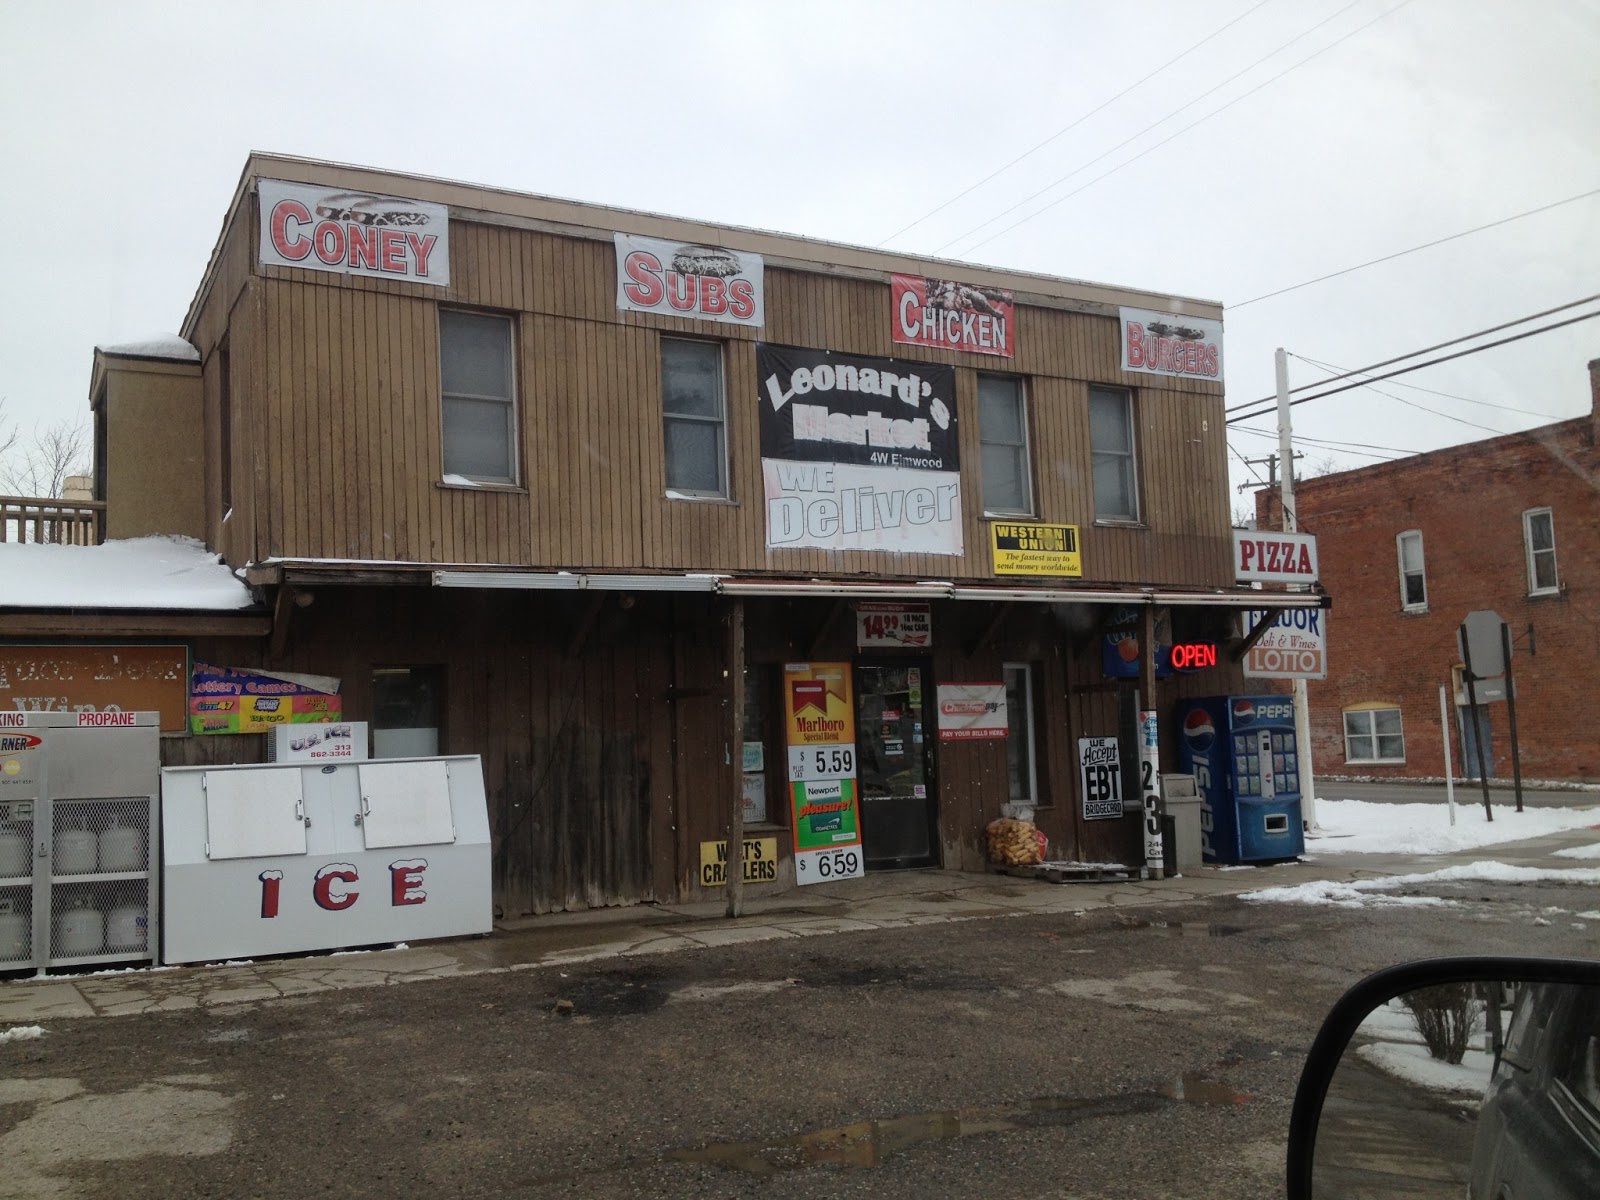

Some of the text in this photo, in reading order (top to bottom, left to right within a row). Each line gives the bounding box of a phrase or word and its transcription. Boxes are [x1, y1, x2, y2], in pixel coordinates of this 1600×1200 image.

[270, 198, 438, 277] CONEY
[623, 250, 756, 319] SUBS
[899, 291, 1007, 351] CHICKEN
[1126, 321, 1219, 377] BURGERS
[765, 364, 950, 430] Leonard's
[792, 403, 931, 451] Market
[870, 452, 888, 464] 4W
[776, 464, 835, 493] WE
[769, 484, 958, 545] Deliver
[997, 526, 1063, 539] WESTERN
[1019, 539, 1064, 551] UNION
[1020, 554, 1044, 562] fastest
[1239, 540, 1313, 574] PIZZA
[1277, 633, 1288, 646] &
[1289, 635, 1317, 649] Wines
[1171, 644, 1217, 668] OPEN
[1254, 650, 1316, 672] LOTTO
[191, 680, 242, 695] Lottery
[246, 682, 297, 694] Games
[78, 713, 135, 726] PROPANE
[1256, 704, 1293, 719] PEPSI
[796, 716, 845, 733] Marlboro
[290, 725, 351, 752] U.S. ICE
[804, 732, 839, 742] Special Blend
[1089, 739, 1105, 748] WE
[311, 750, 351, 758] 862-3344
[816, 750, 852, 773] 5.59
[1082, 744, 1118, 766] Accept
[808, 786, 839, 795] Newport
[1085, 764, 1119, 801] EBT
[1085, 803, 1122, 816] BRIDGECARD
[716, 841, 762, 862] WT'S
[703, 860, 776, 883] CRLERS
[819, 852, 858, 878] 6.59
[259, 858, 429, 919] ICE
